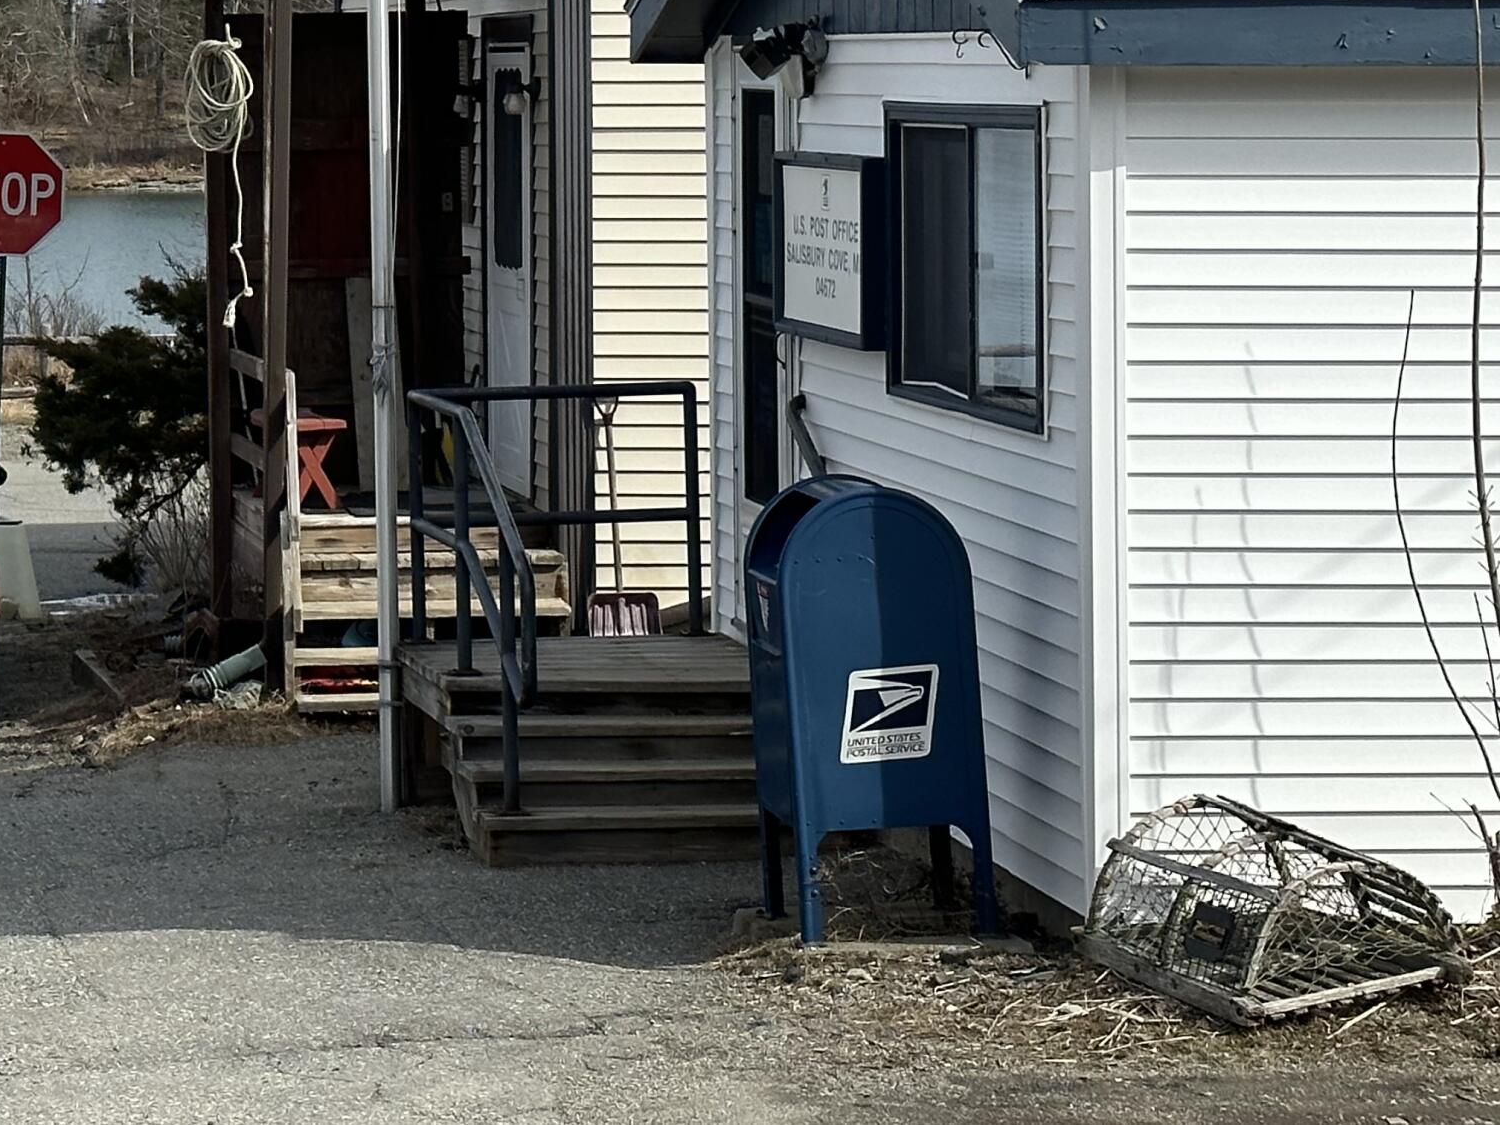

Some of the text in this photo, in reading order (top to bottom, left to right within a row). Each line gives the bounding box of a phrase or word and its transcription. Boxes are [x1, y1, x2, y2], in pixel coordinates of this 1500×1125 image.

[793, 214, 859, 243] U.S. POST OFFICE
[786, 241, 859, 275] SALISBURY COVE, M
[846, 741, 925, 758] POSTAL SERVICE
[847, 732, 922, 747] UNITED STATES
